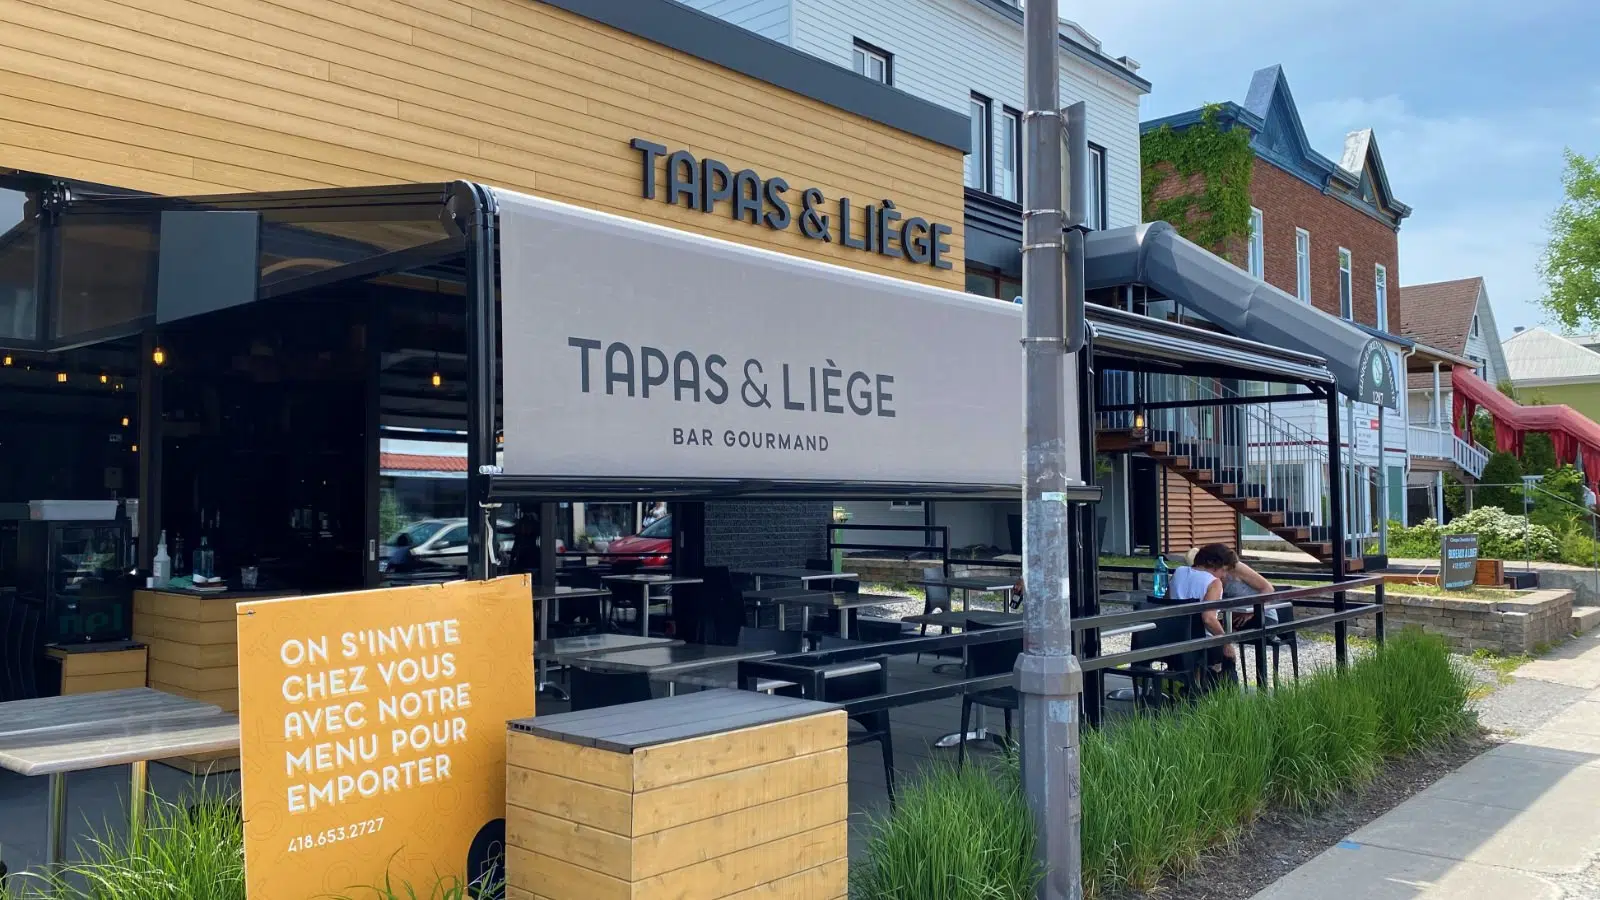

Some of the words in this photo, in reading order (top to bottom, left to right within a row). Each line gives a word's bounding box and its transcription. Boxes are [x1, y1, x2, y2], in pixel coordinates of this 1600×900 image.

[630, 137, 791, 230] TAPAS
[799, 187, 832, 243] &
[839, 198, 953, 270] LIÈGE
[567, 336, 729, 405] TAPAS
[740, 358, 772, 409] &
[782, 358, 896, 418] LIÈGE
[672, 427, 714, 446] BAR
[723, 430, 829, 451] GOURMAND
[280, 635, 328, 668] ON
[341, 619, 461, 658] S'INVITE
[282, 665, 368, 704] CHEZ
[377, 652, 457, 687] VOUS
[284, 701, 367, 741] AVEC
[378, 682, 471, 723] NOTRE
[286, 733, 378, 776] MENU
[391, 716, 467, 757] POUR
[287, 754, 452, 813] EMPORTER
[287, 817, 385, 852] 418.653.2727
